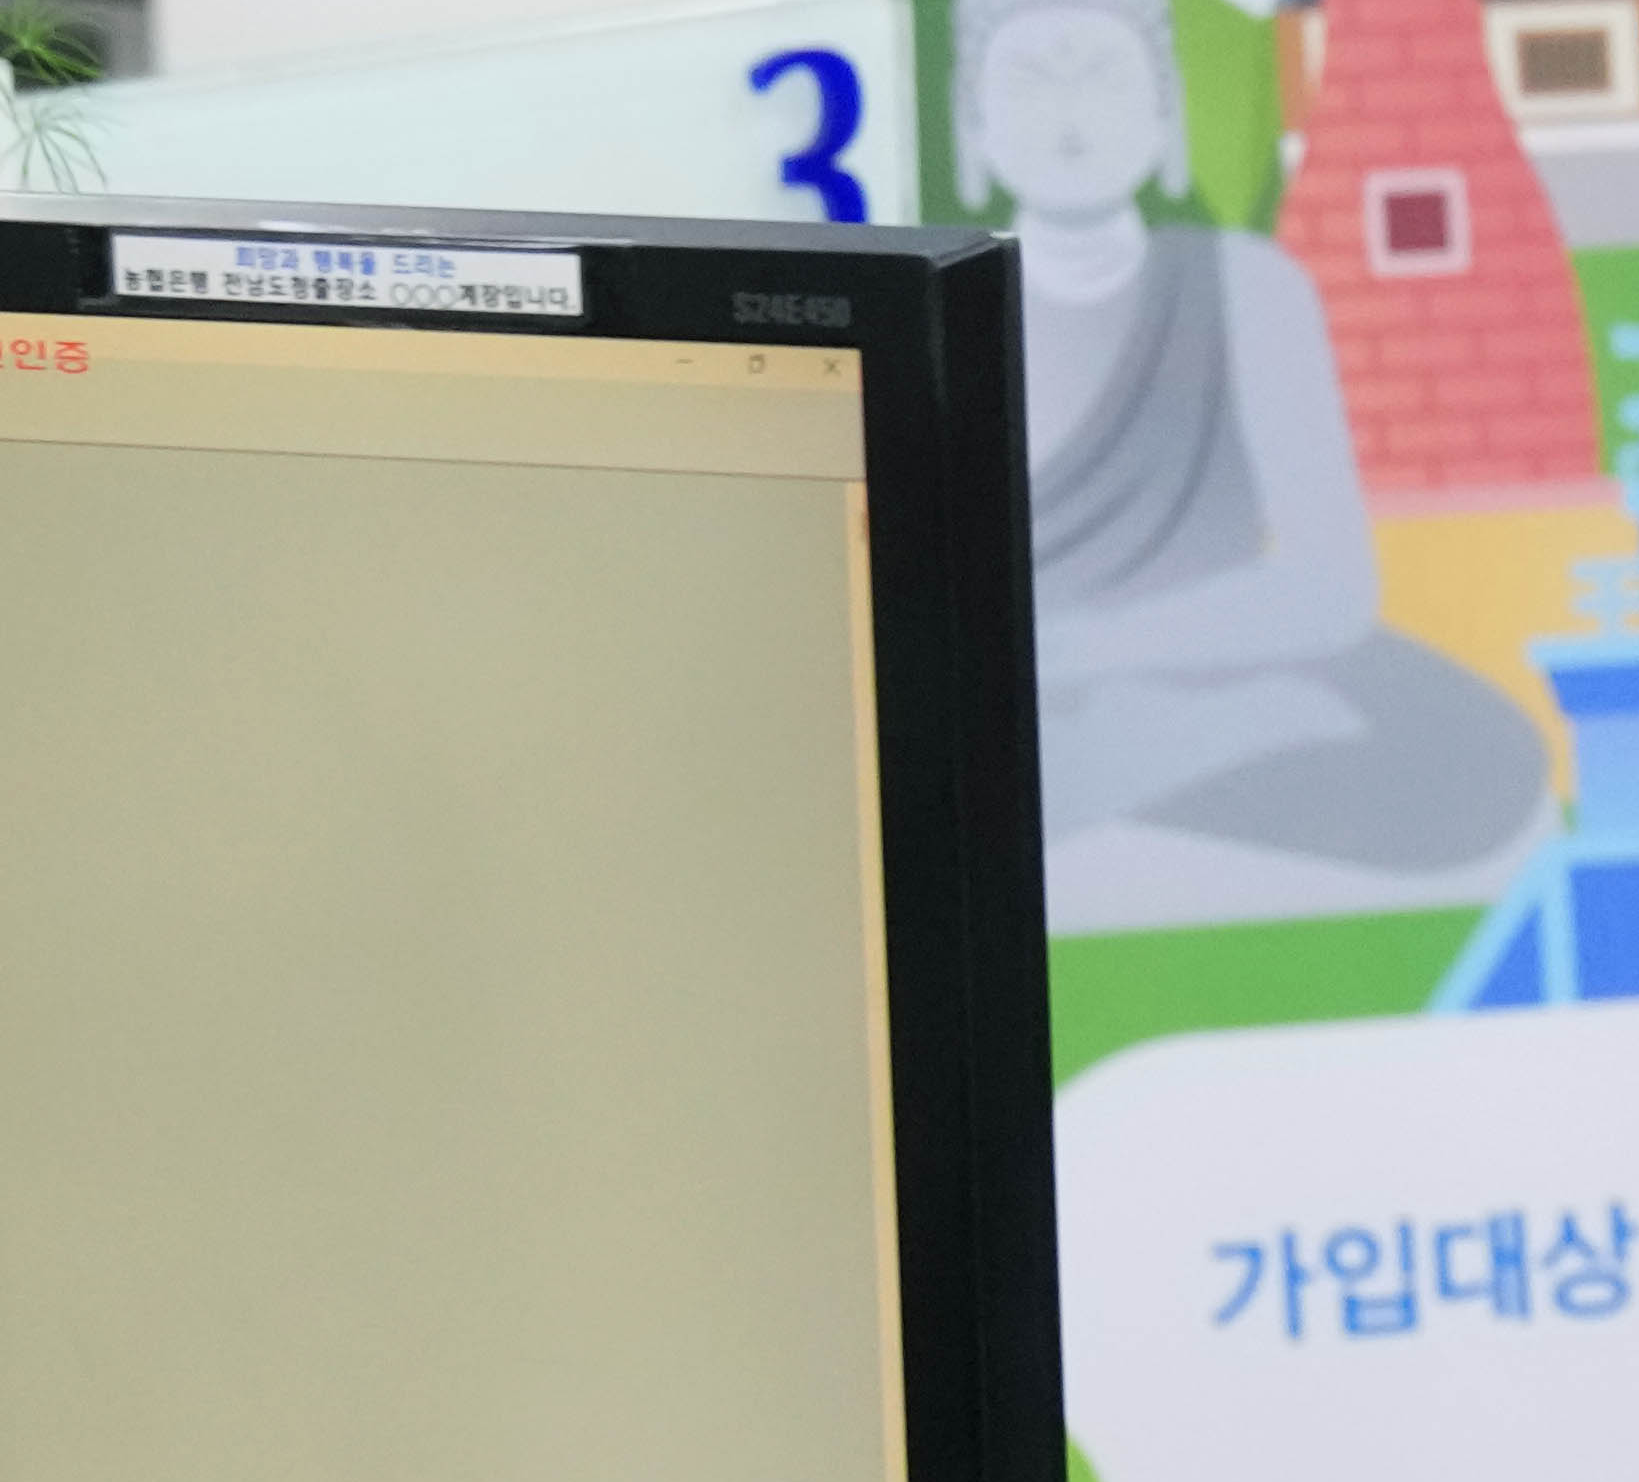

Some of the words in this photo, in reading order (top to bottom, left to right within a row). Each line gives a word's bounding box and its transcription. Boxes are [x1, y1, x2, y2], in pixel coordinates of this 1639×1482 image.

[746, 47, 868, 224] 3
[234, 245, 300, 270] 희망과
[313, 248, 377, 276] 행복을
[392, 253, 457, 279] 드리는
[0, 338, 90, 374] 인증
